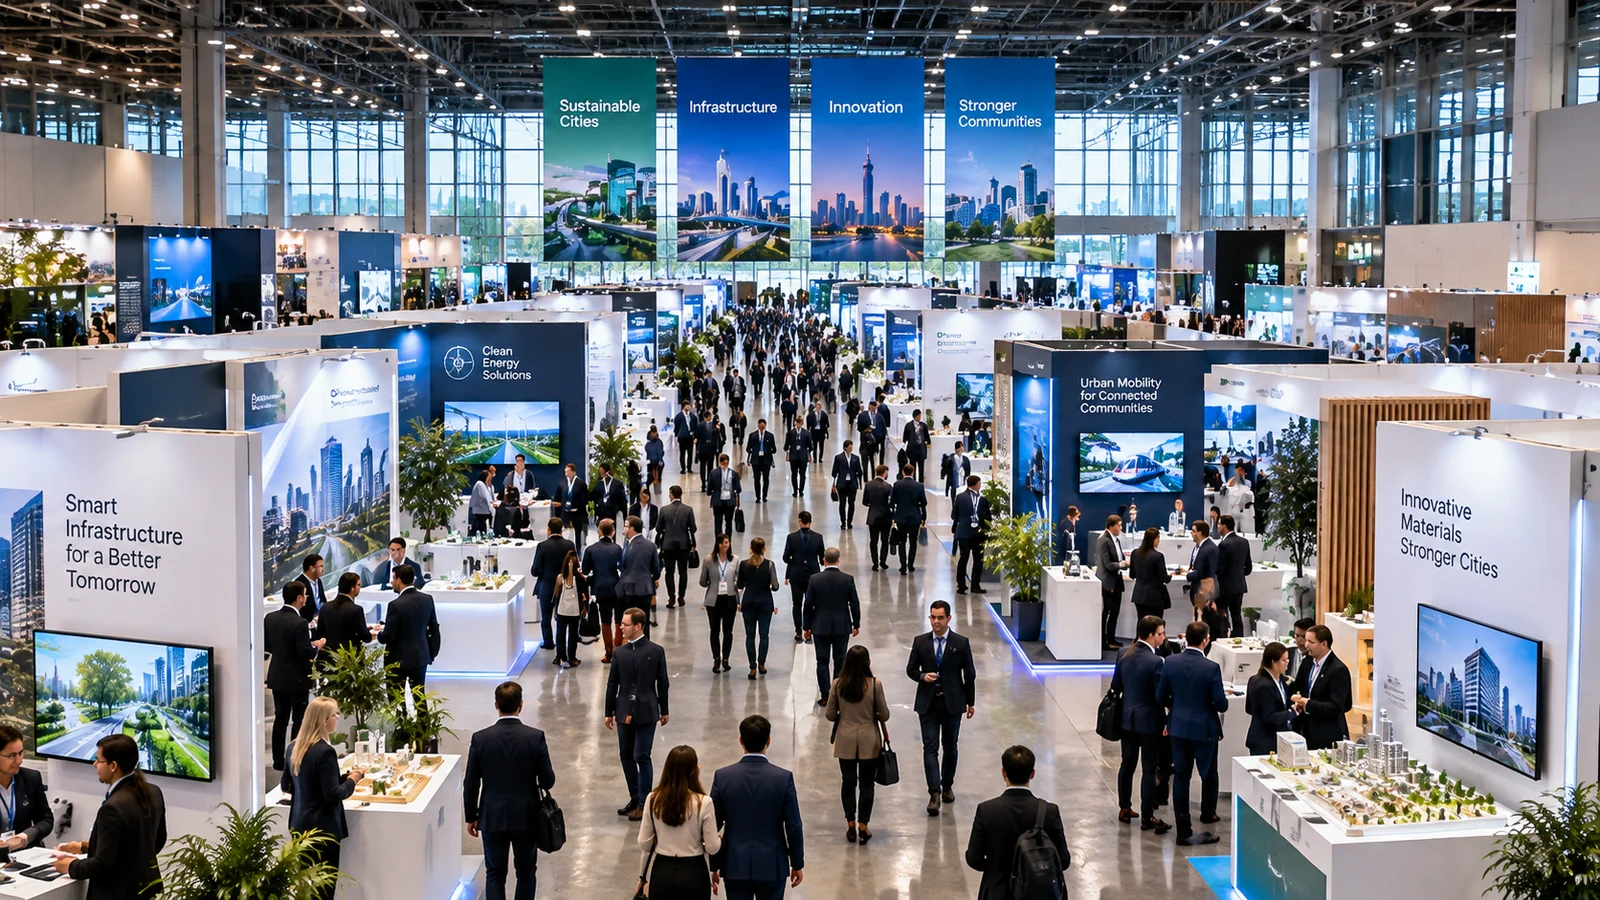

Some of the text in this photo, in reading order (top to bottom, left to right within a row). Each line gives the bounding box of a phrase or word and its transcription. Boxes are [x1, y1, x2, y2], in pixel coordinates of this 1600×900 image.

[560, 98, 641, 113] Sustainable
[689, 100, 778, 114] Infrastructure
[829, 100, 904, 114] Innovation
[959, 98, 1017, 114] Stronger
[559, 114, 600, 128] Cities
[958, 114, 1042, 128] Communities
[482, 345, 513, 356] Clean
[482, 357, 519, 370] Energy
[482, 369, 532, 380] Solutions
[1080, 377, 1162, 390] Urban Mobility
[1079, 390, 1158, 401] for Connected
[1080, 402, 1153, 414] Communities
[66, 493, 118, 515] Smart
[1401, 487, 1472, 520] Innovative
[66, 519, 183, 546] Infrastructure
[1401, 512, 1463, 544] Materials
[66, 543, 161, 569] for a Better
[1400, 536, 1499, 579] Stronger Cities
[66, 569, 156, 595] Tomorrow
